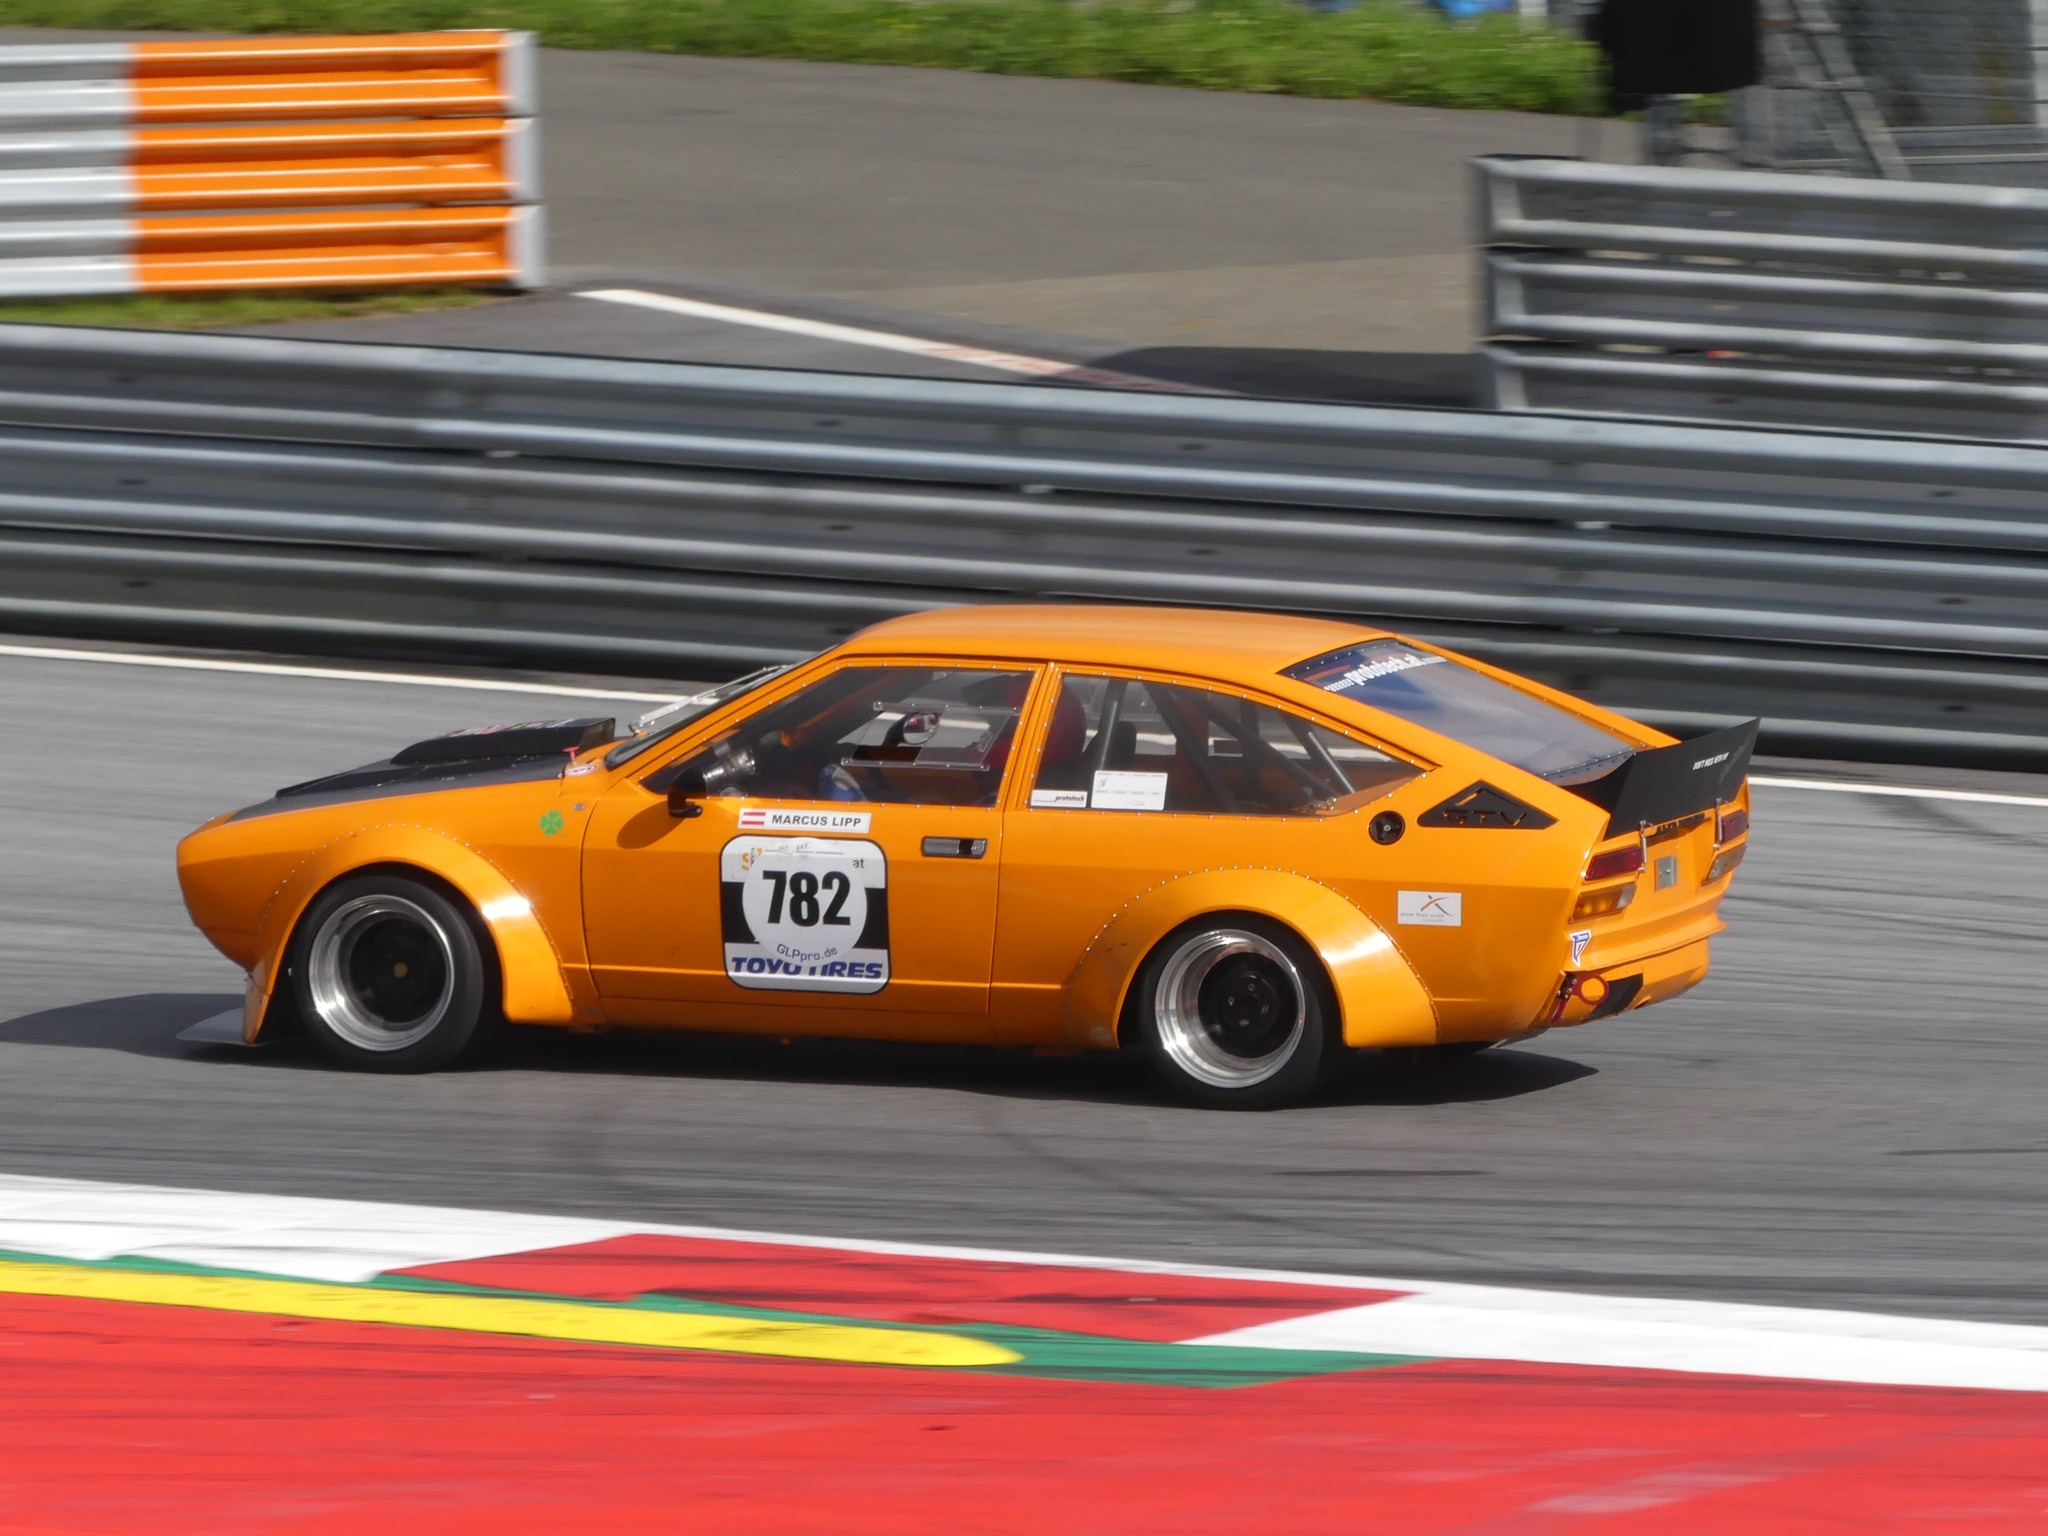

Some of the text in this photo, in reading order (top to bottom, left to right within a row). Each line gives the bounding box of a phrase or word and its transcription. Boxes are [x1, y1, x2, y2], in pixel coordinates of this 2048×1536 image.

[771, 814, 861, 827] MARCUS LIPP
[762, 870, 851, 927] 782
[776, 943, 838, 962] GLPpro.de
[731, 957, 800, 975] TOYO
